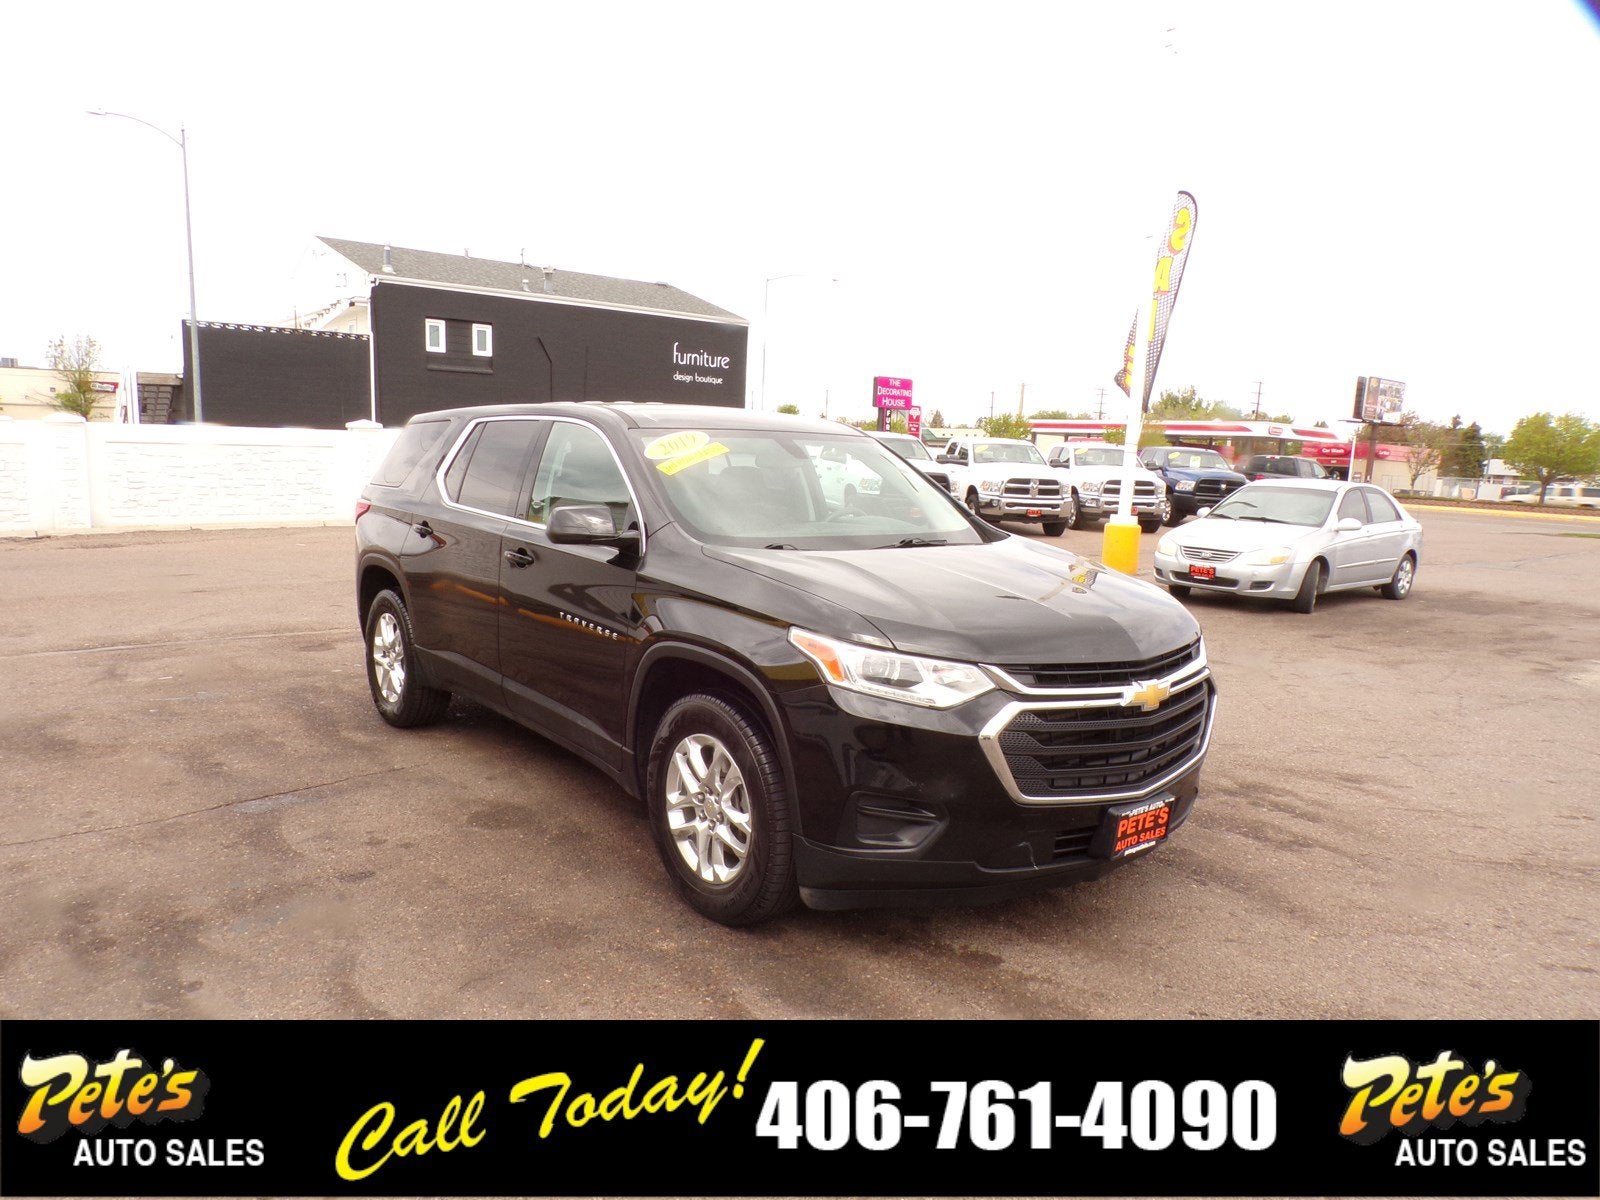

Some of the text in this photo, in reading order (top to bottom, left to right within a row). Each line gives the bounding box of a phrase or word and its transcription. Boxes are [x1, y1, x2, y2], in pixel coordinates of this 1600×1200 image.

[673, 342, 730, 369] furniture
[673, 370, 723, 385] design boutique
[889, 378, 901, 387] THE
[877, 386, 912, 397] DECORATING
[882, 397, 906, 407] HOUSE
[560, 611, 618, 640] TRAVERSE
[1117, 806, 1169, 838] PETE'S
[1114, 835, 1138, 852] AUTO
[1139, 826, 1166, 842] SALES
